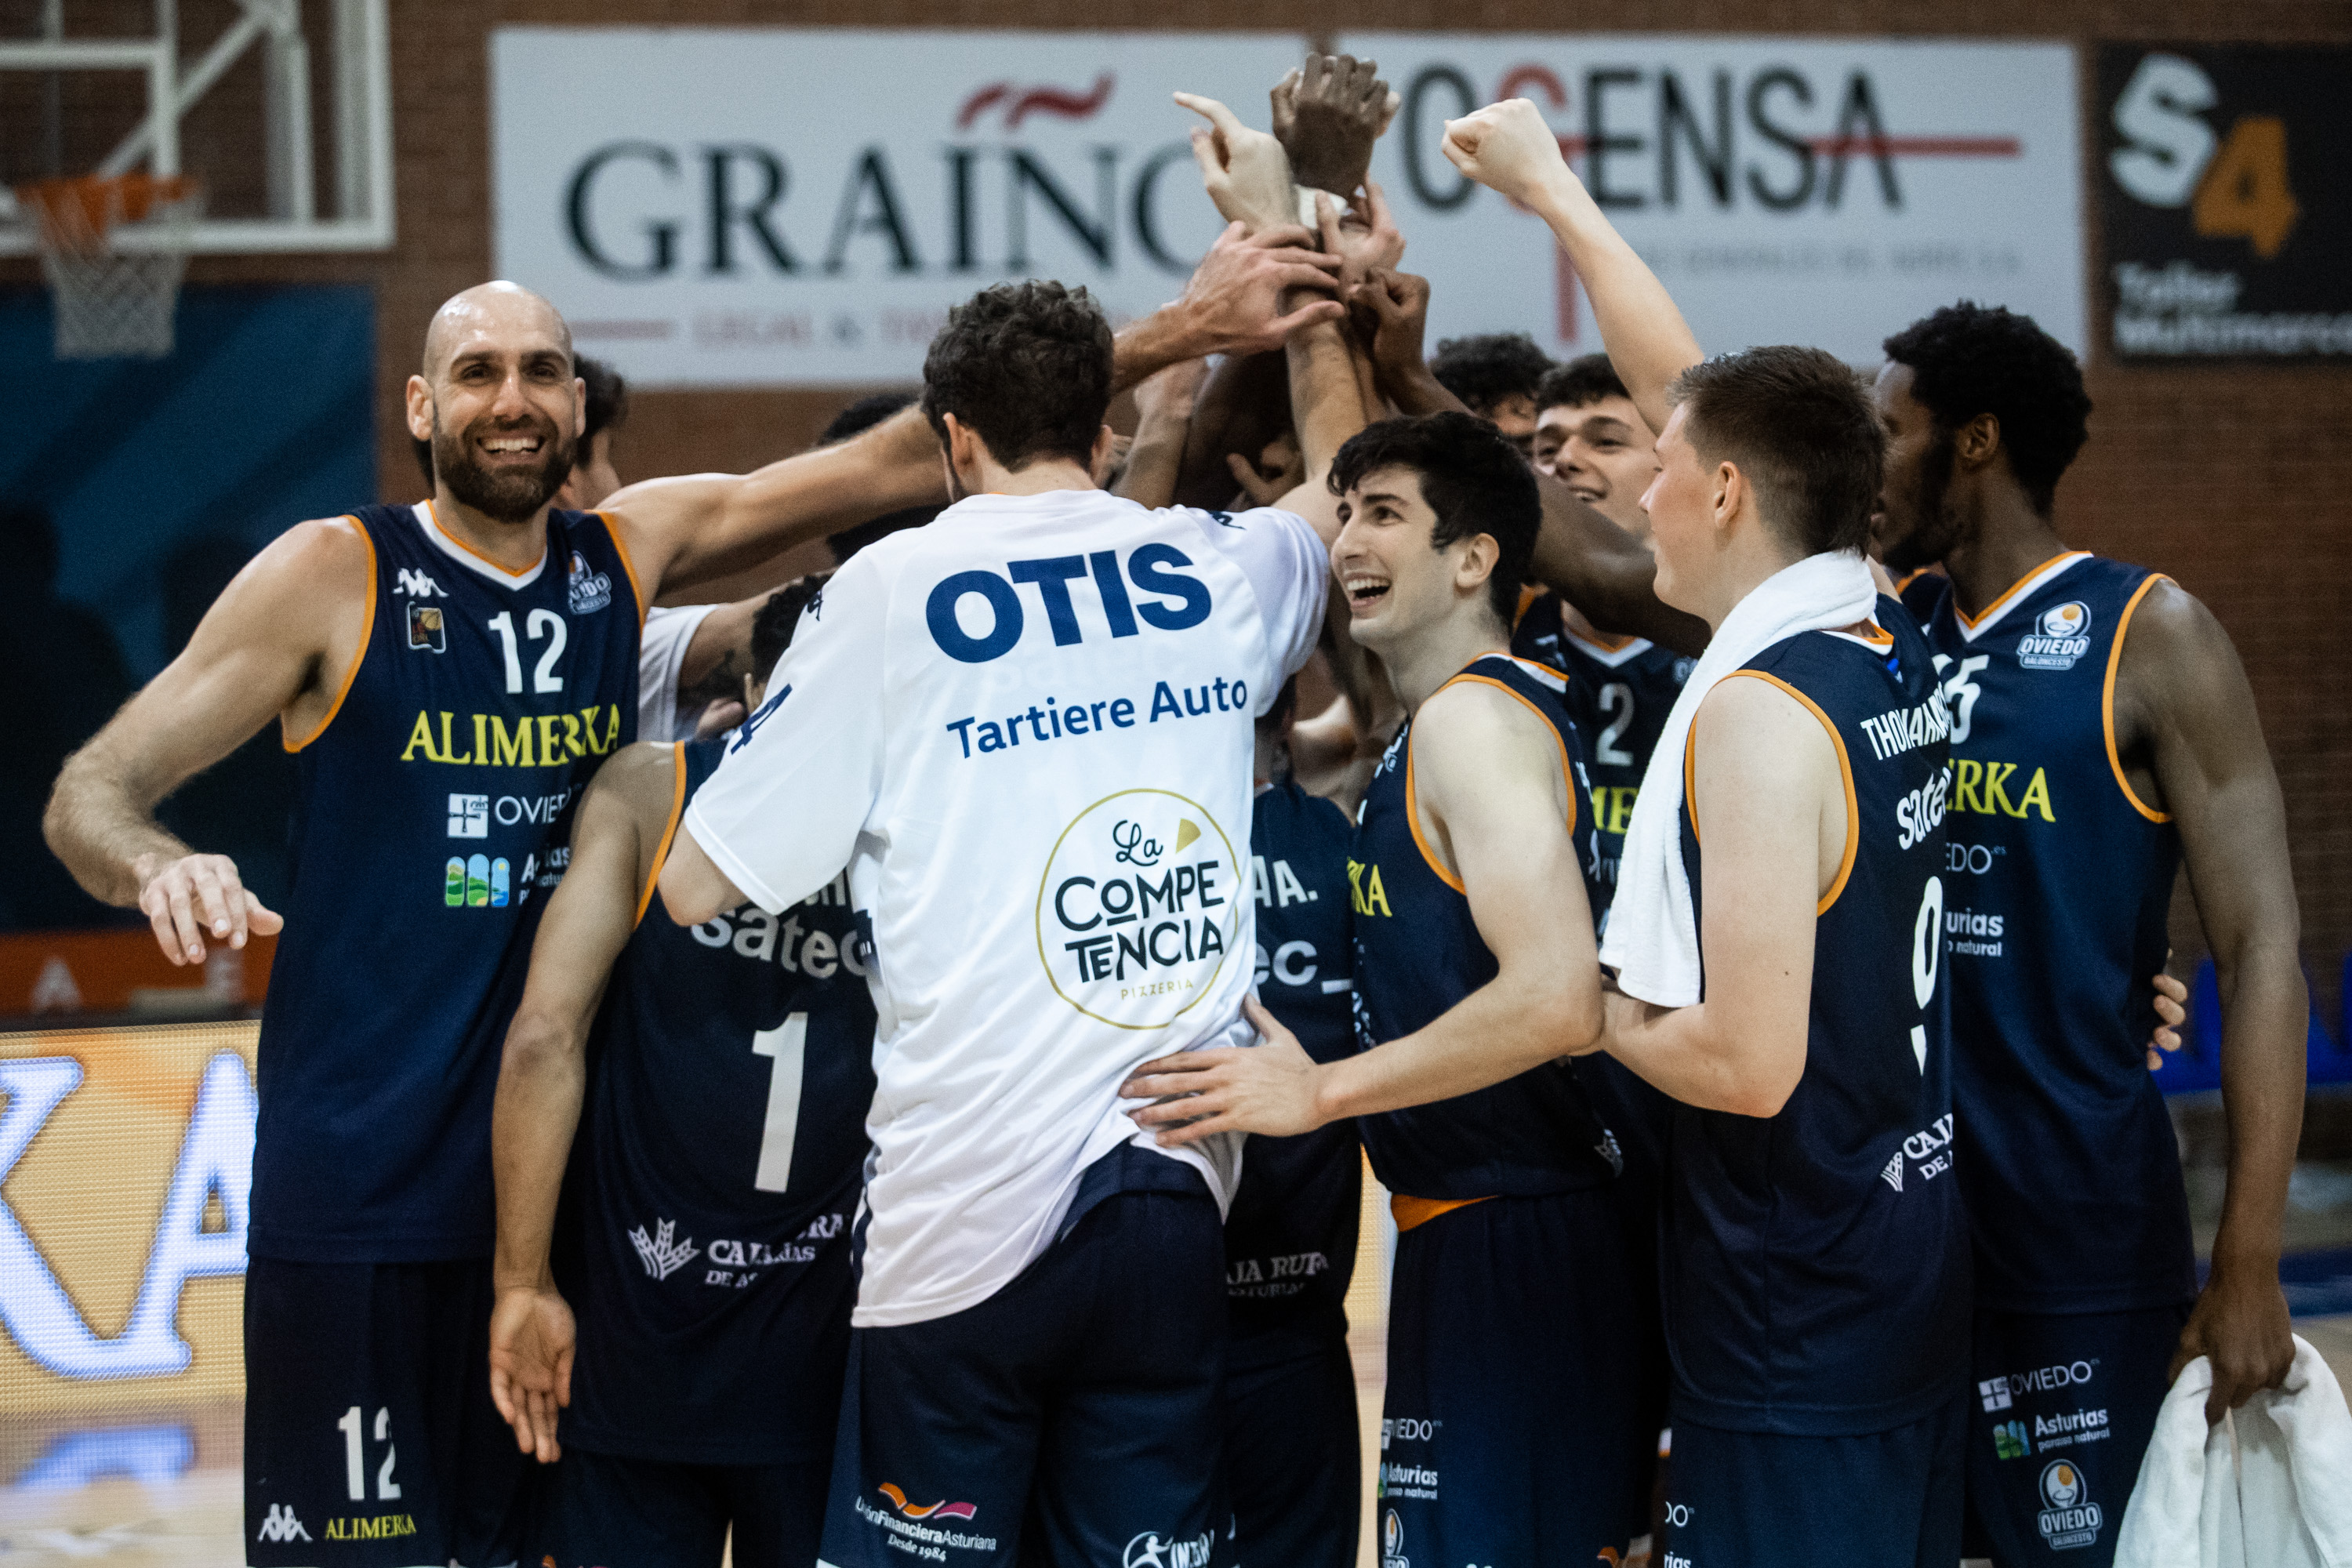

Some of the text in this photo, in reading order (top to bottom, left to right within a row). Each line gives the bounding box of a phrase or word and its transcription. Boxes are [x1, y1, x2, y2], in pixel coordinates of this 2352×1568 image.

[926, 543, 1211, 662] OTIS
[488, 608, 568, 694] 12
[2020, 637, 2086, 656] OVIEDO
[401, 702, 620, 767] ALIMERKA
[946, 676, 1247, 758] Tartiere Auto
[1596, 682, 1635, 766] 2
[1112, 819, 1163, 866] La
[1055, 860, 1224, 931] COMPE
[1065, 916, 1224, 982] TENCIA
[1122, 978, 1194, 1000] PIZZERIA
[752, 1011, 809, 1193] 1
[1918, 1156, 1949, 1180] DE
[338, 1406, 401, 1501] 12
[2035, 1408, 2109, 1437] Asturias
[887, 1534, 947, 1563] Desde 1984
[2040, 1506, 2100, 1534] OVIEDO
